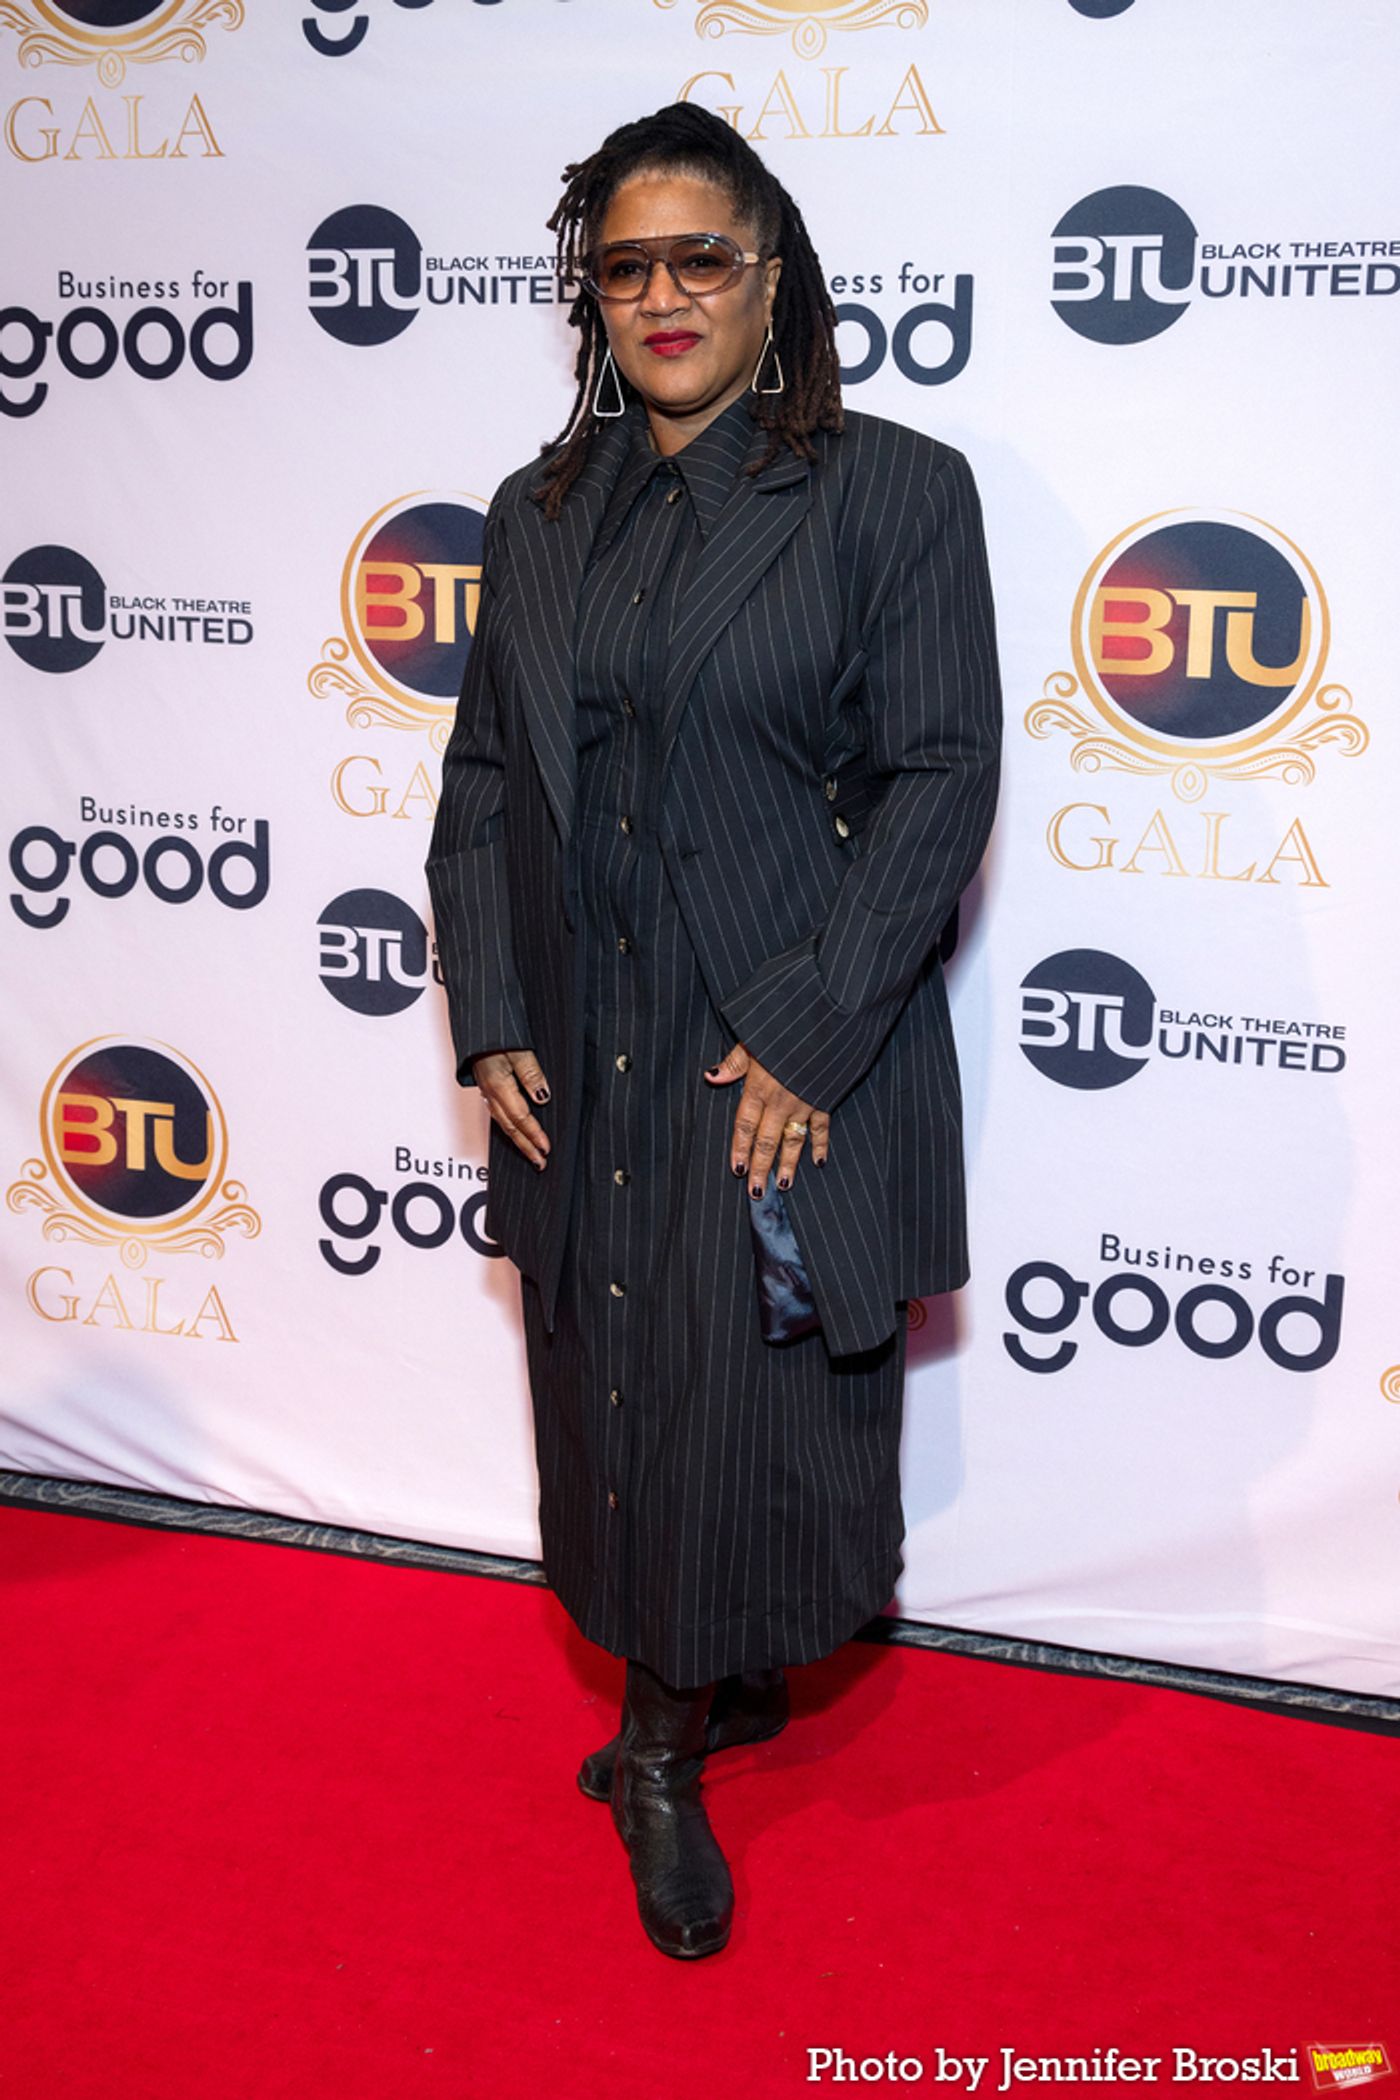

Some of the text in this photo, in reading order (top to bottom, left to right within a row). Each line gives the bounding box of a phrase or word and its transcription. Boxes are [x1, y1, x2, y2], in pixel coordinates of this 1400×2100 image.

[4, 93, 226, 162] GALA
[304, 248, 422, 311] BTU
[426, 257, 489, 270] BLACK
[898, 262, 945, 293] for
[1049, 233, 1198, 304] BTU
[1202, 242, 1400, 259] BLACK THEATRE
[58, 270, 230, 298] Business for
[426, 275, 583, 304] UNITED
[1201, 264, 1400, 298] UNITED
[834, 274, 974, 386] od
[0, 583, 107, 643] BTU
[110, 596, 251, 614] BLACK THEATRE
[110, 613, 254, 645] UNITED
[1089, 586, 1312, 687] BTU
[81, 797, 247, 833] Business for
[330, 755, 441, 821] GA
[9, 820, 270, 930] good
[1046, 803, 1331, 887] GALA
[317, 924, 428, 989] BTU
[1020, 987, 1157, 1060] BTU
[1159, 1028, 1346, 1073] UNITED
[1160, 1009, 1345, 1040] BLACK THEATRE
[53, 1092, 214, 1180] BTU
[395, 1146, 489, 1181] Busine
[1101, 1234, 1315, 1287] Business for
[26, 1266, 240, 1343] GALA
[1003, 1261, 1345, 1373] good
